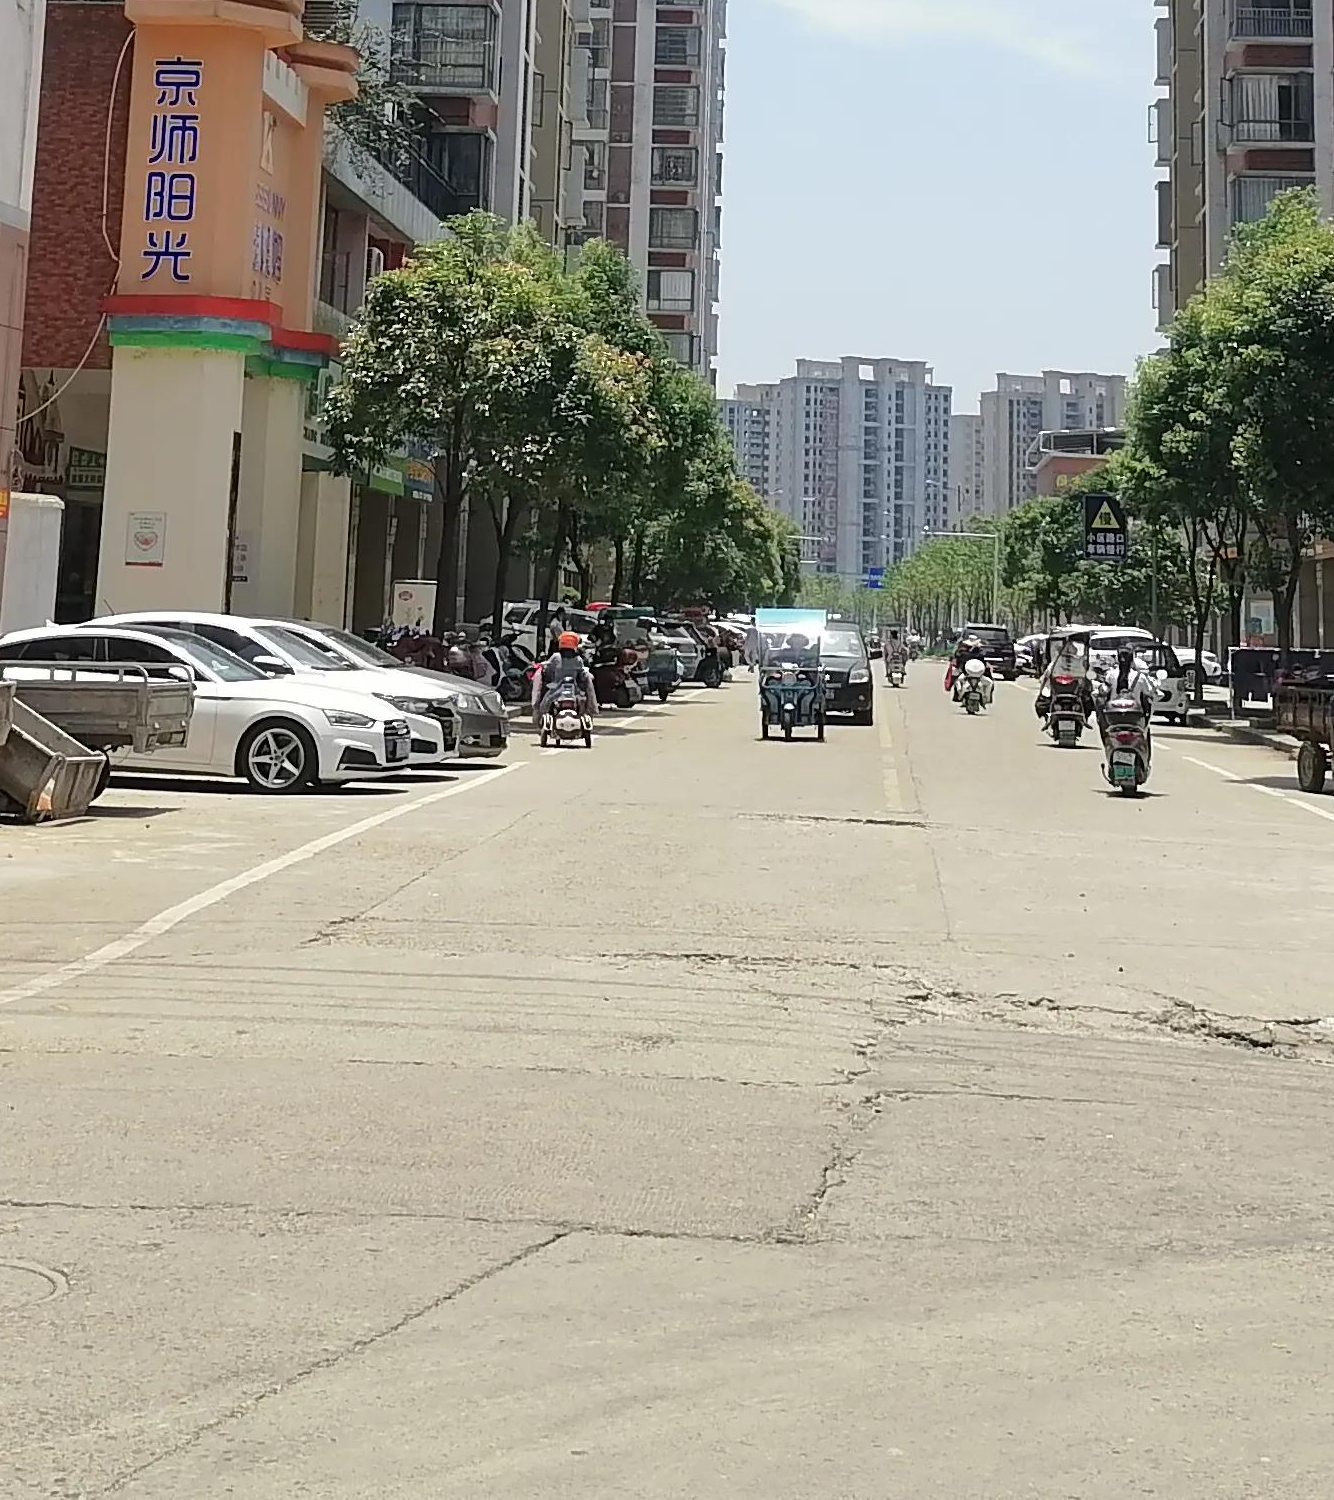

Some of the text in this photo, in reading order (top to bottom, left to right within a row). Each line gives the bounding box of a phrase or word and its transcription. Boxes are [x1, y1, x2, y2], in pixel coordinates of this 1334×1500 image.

[140, 55, 205, 284] 京师阳光
[1087, 532, 1125, 543] 小区路口
